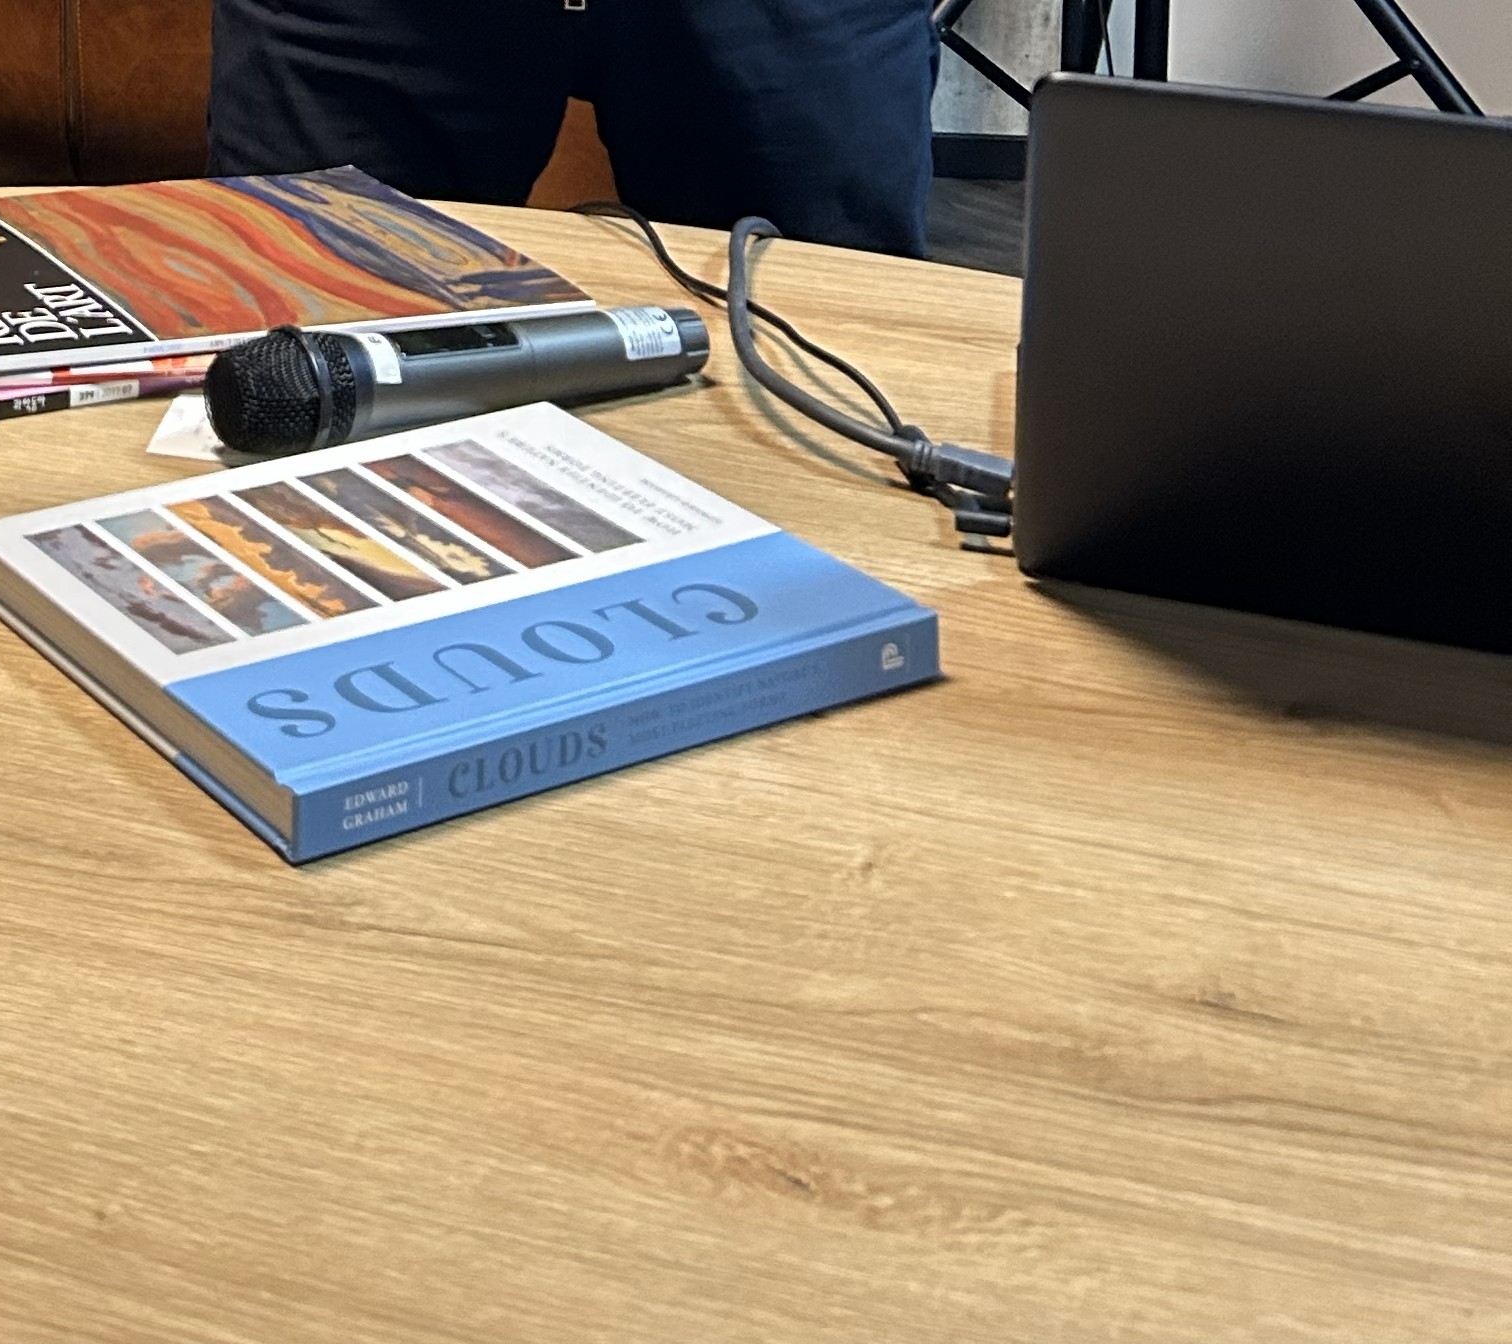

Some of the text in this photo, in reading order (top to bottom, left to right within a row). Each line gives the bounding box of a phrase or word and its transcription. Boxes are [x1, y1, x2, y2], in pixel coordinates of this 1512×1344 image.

[2, 307, 79, 344] DE
[24, 282, 134, 339] L'ART
[245, 582, 760, 739] CLOUDS
[447, 723, 609, 799] CLOUDS
[342, 799, 409, 830] GRAHAM
[343, 780, 410, 811] EDWARD
